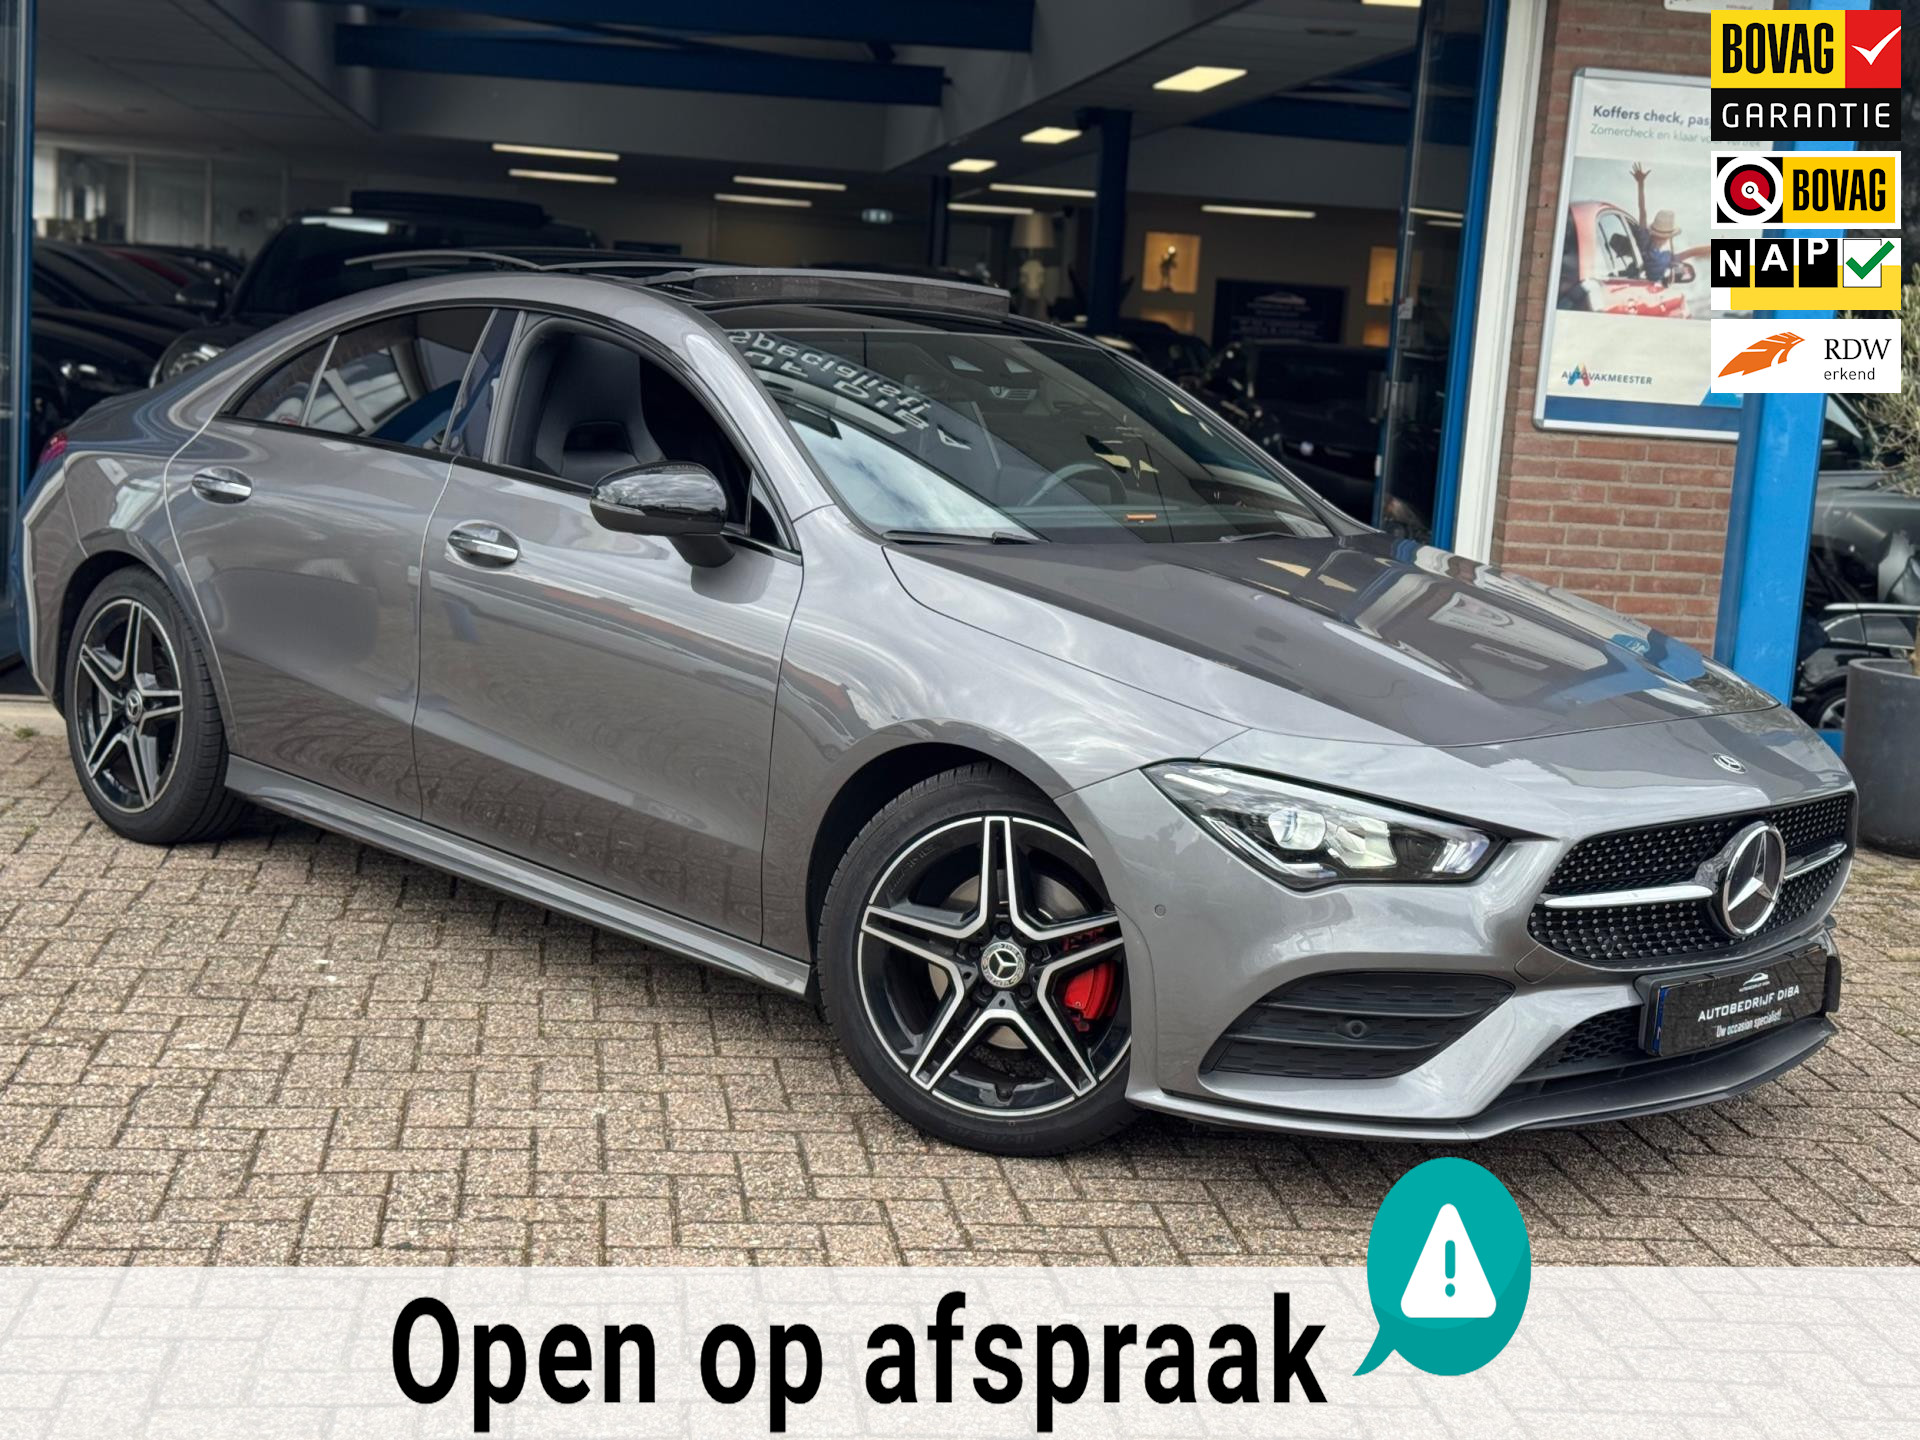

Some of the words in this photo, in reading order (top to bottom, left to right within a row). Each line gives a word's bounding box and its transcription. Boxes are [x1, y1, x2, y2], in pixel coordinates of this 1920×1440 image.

[1593, 105, 1640, 120] Koffers
[1643, 109, 1684, 126] check,
[1590, 123, 1654, 139] Zomercheck
[1656, 131, 1670, 141] en
[1673, 130, 1698, 143] klaar
[1697, 992, 1775, 1022] AUTOBEDRIJF
[1777, 984, 1800, 1001] DIBA
